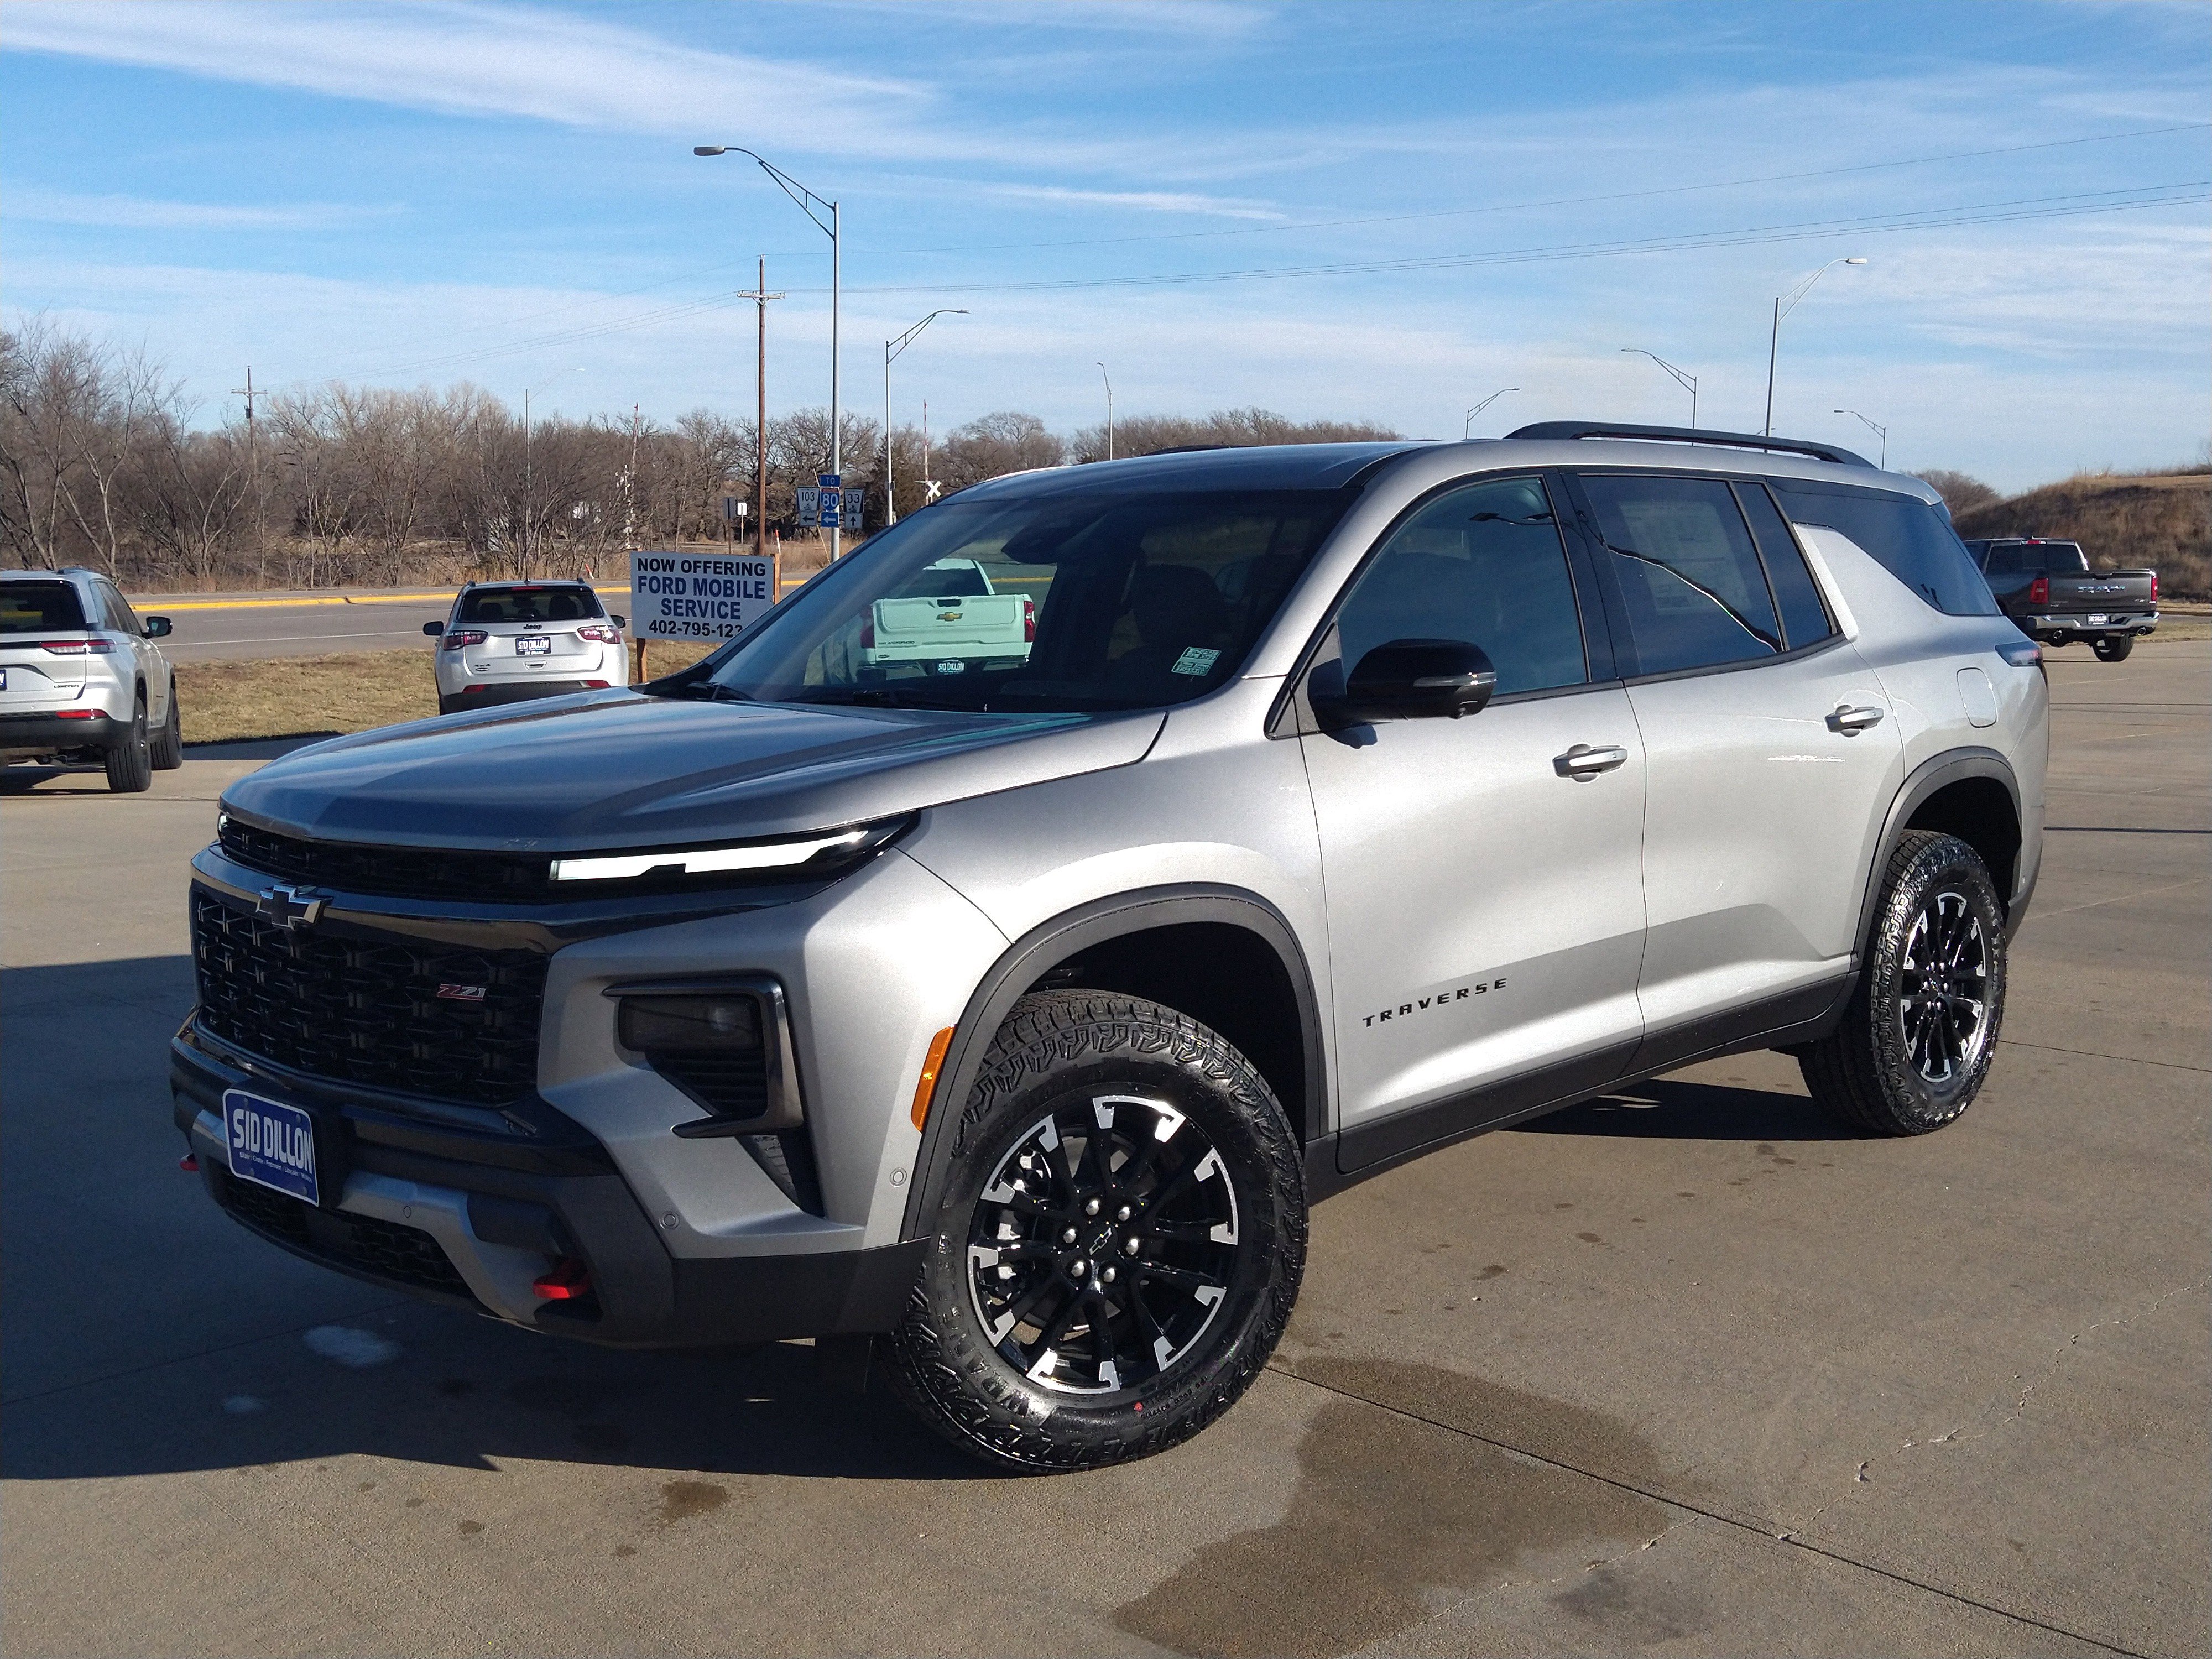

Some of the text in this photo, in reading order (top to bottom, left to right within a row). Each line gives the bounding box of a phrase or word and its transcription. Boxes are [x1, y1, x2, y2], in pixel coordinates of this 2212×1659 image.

[801, 491, 815, 502] 103
[822, 493, 838, 507] 80
[847, 493, 860, 503] 33
[637, 557, 766, 577] NOW OFFERING
[638, 575, 766, 599] FORD MOBILE
[661, 598, 741, 620] SERVICE
[529, 639, 549, 649] DILLON
[436, 983, 486, 1001] Z71
[1362, 978, 1507, 1027] TRAVERSE
[233, 1108, 312, 1175] SID DILLON
